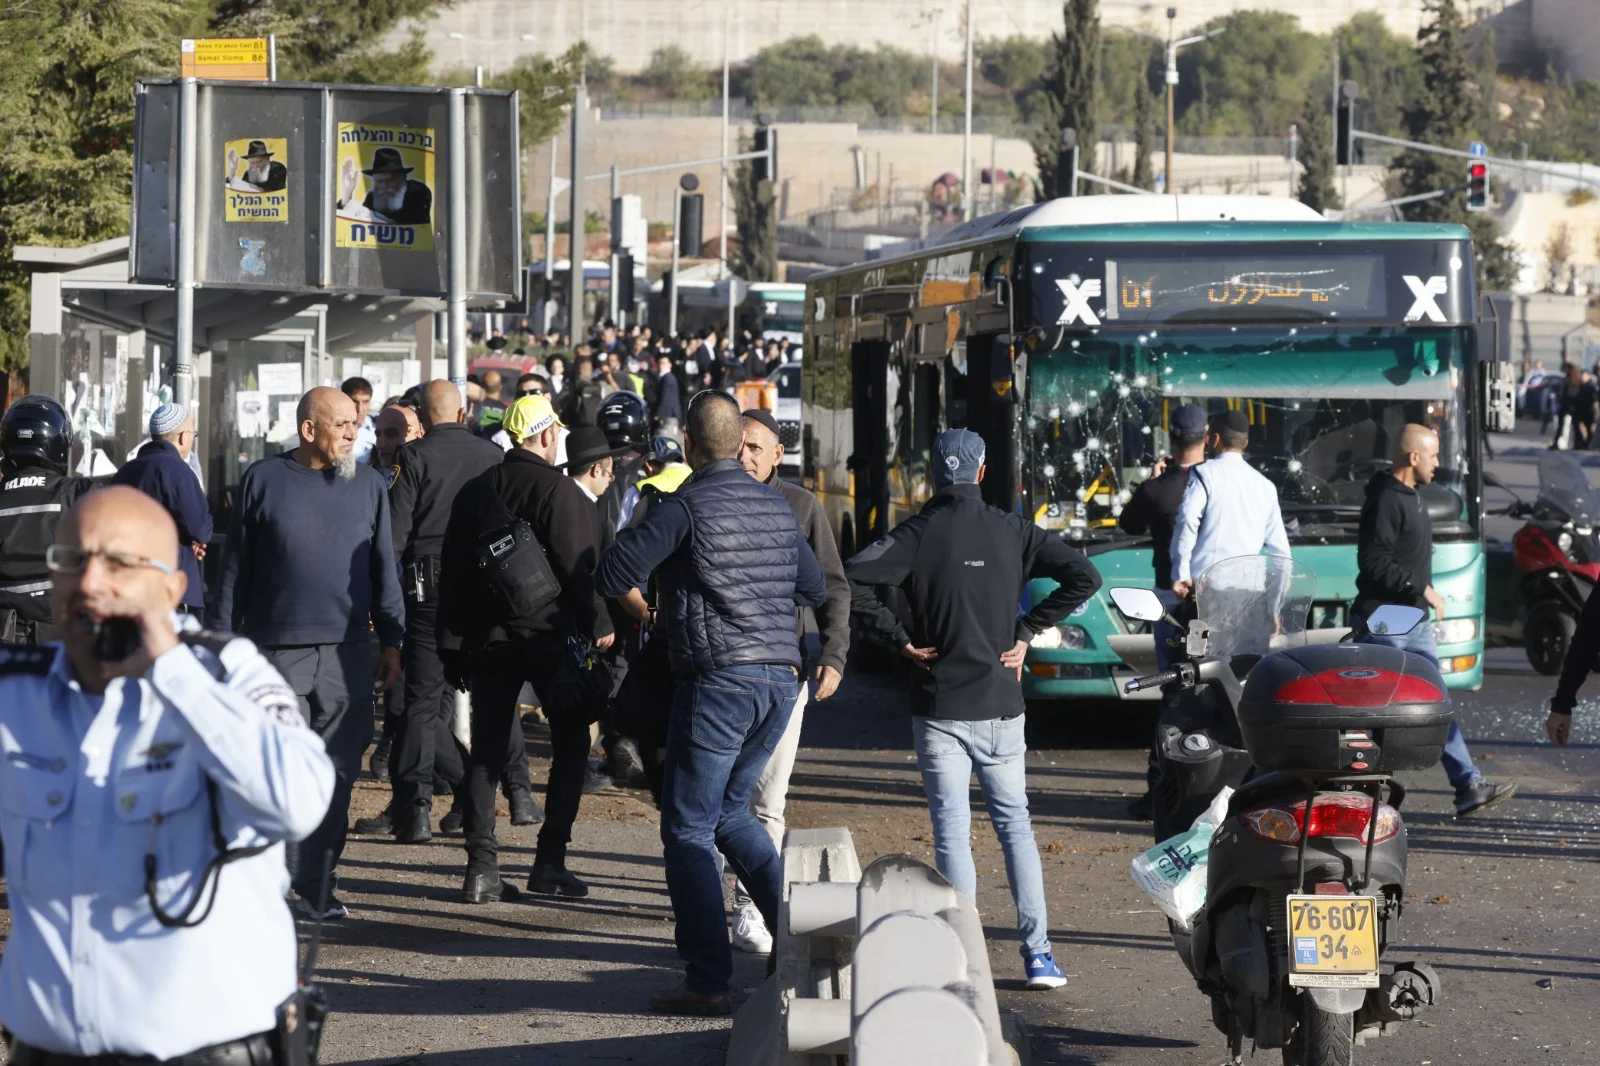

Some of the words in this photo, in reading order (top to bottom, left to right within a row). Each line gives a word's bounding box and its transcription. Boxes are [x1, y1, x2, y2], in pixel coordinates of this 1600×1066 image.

[253, 41, 263, 49] 81
[252, 54, 264, 62] 86
[341, 126, 393, 143] והצלחה
[398, 131, 433, 148] ברכה
[229, 194, 262, 208] המלך
[266, 196, 285, 205] יחי
[237, 208, 279, 217] המשיח
[351, 224, 415, 245] משיח
[1293, 905, 1369, 931] 76-607
[1320, 934, 1348, 959] 34
[1303, 950, 1311, 958] IL
